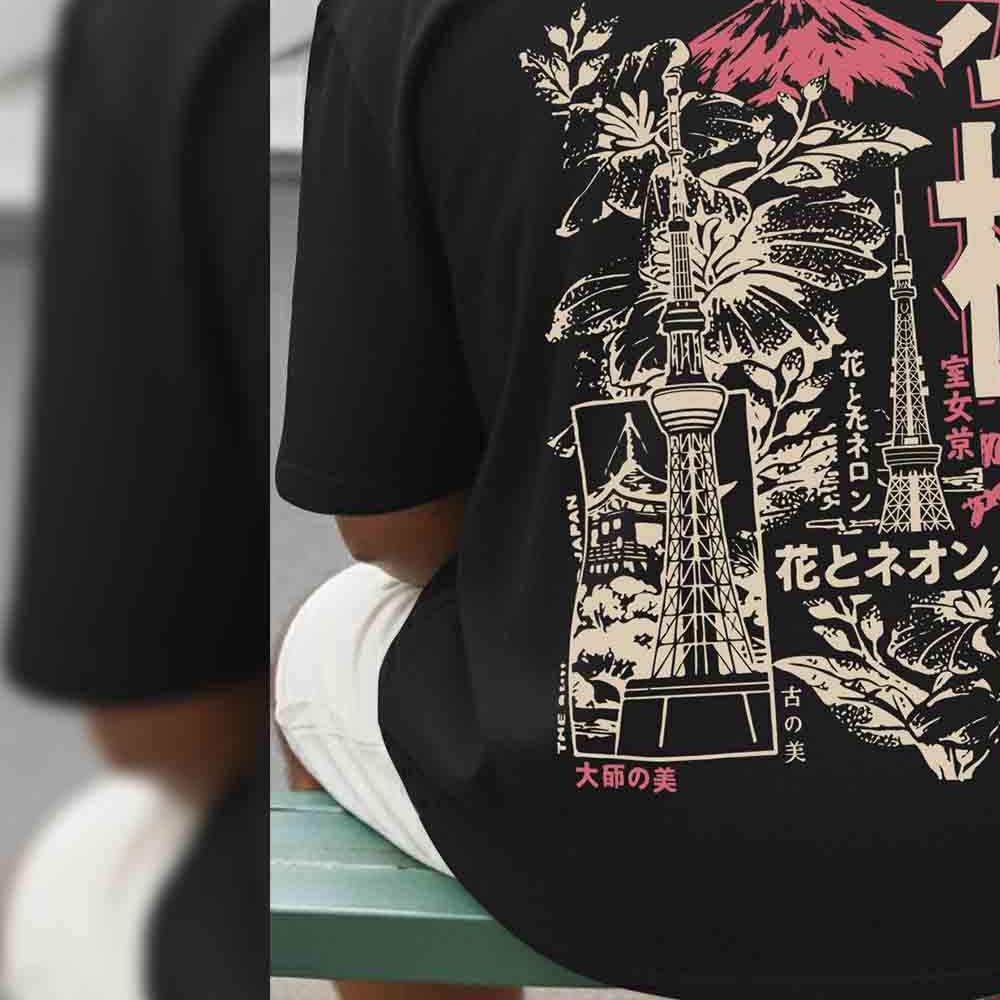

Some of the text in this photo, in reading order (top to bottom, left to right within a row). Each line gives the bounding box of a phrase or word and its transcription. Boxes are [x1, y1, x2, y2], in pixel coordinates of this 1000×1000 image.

[565, 494, 584, 563] JAPAN
[774, 539, 989, 593] 花とネオン
[780, 685, 807, 764] 古の美
[575, 760, 678, 793] 大師の美
